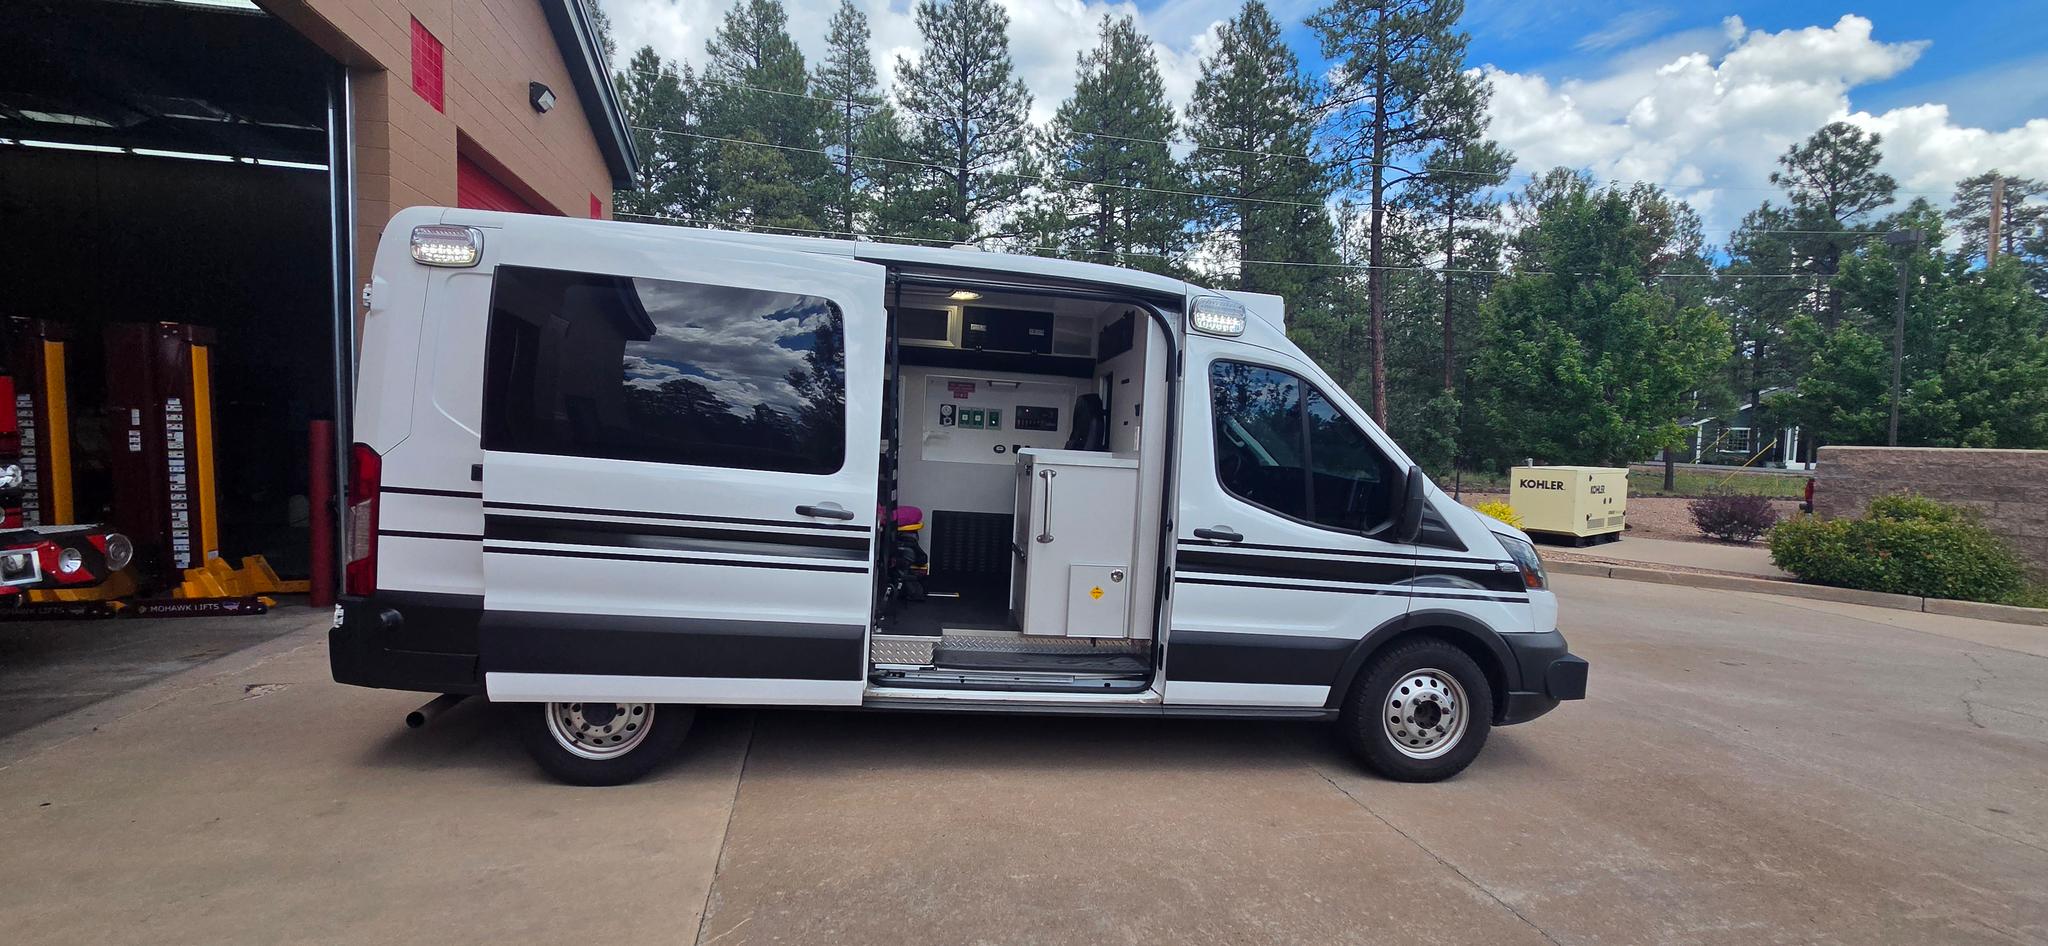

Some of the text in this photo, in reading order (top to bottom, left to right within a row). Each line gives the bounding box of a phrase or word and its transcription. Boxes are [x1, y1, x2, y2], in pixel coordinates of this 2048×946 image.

[1519, 479, 1565, 490] KOHLER
[150, 603, 220, 613] MOHAWK LIFTS
